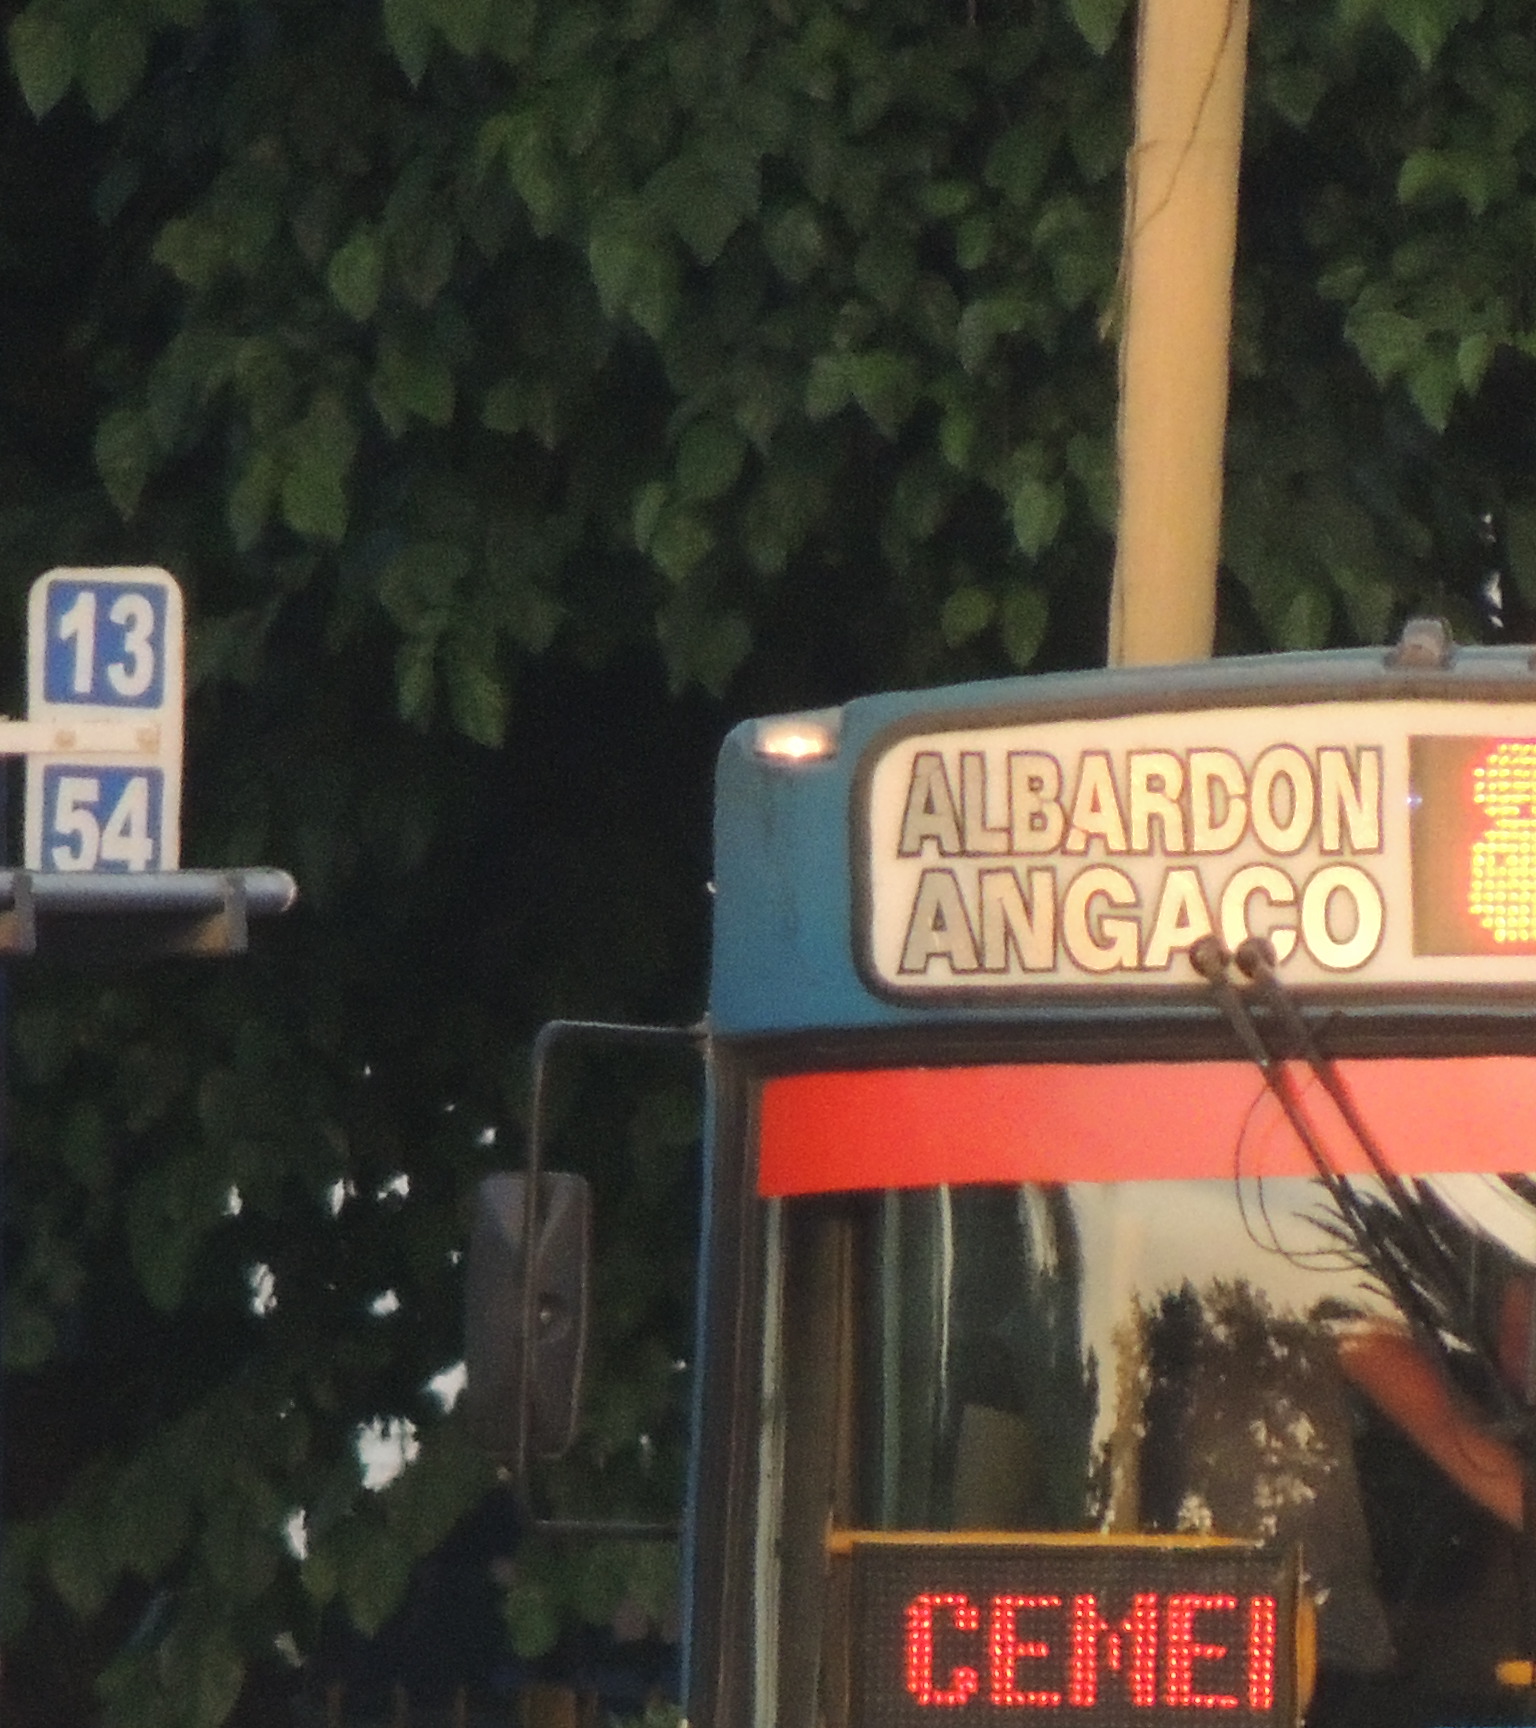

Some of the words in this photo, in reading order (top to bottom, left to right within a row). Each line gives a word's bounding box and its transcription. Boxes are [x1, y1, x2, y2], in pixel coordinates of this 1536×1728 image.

[59, 592, 155, 697] 13
[52, 776, 153, 870] 54
[896, 743, 1384, 859] ALBARDON
[896, 862, 1384, 975] ANGACO
